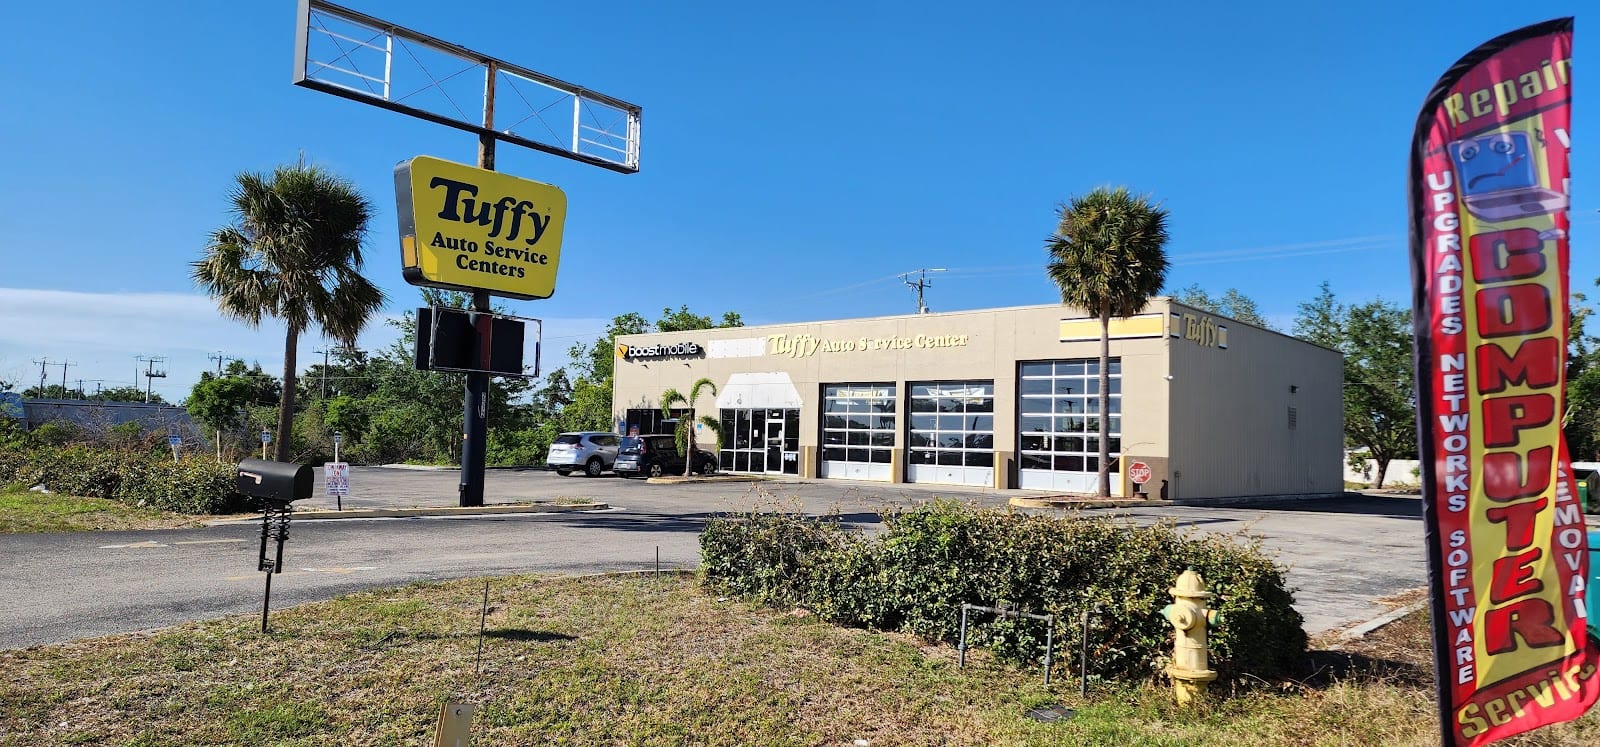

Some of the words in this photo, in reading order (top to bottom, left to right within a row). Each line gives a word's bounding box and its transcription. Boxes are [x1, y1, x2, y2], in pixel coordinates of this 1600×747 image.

[1443, 58, 1572, 128] Repair
[429, 176, 551, 246] Tuffy
[431, 231, 478, 253] Auto
[484, 240, 548, 265] Service
[456, 254, 525, 278] Centers
[1427, 171, 1463, 335] UPGRADES
[767, 333, 821, 359] Tuffy
[821, 338, 856, 353] Auto
[859, 336, 913, 352] Srvice
[914, 333, 969, 349] Center
[1183, 313, 1218, 347] Tuffy
[1438, 352, 1470, 513] NETWORKS
[1469, 227, 1566, 656] COMPUTER
[1130, 468, 1150, 478] STOP
[1447, 530, 1476, 684] SOFTWARE
